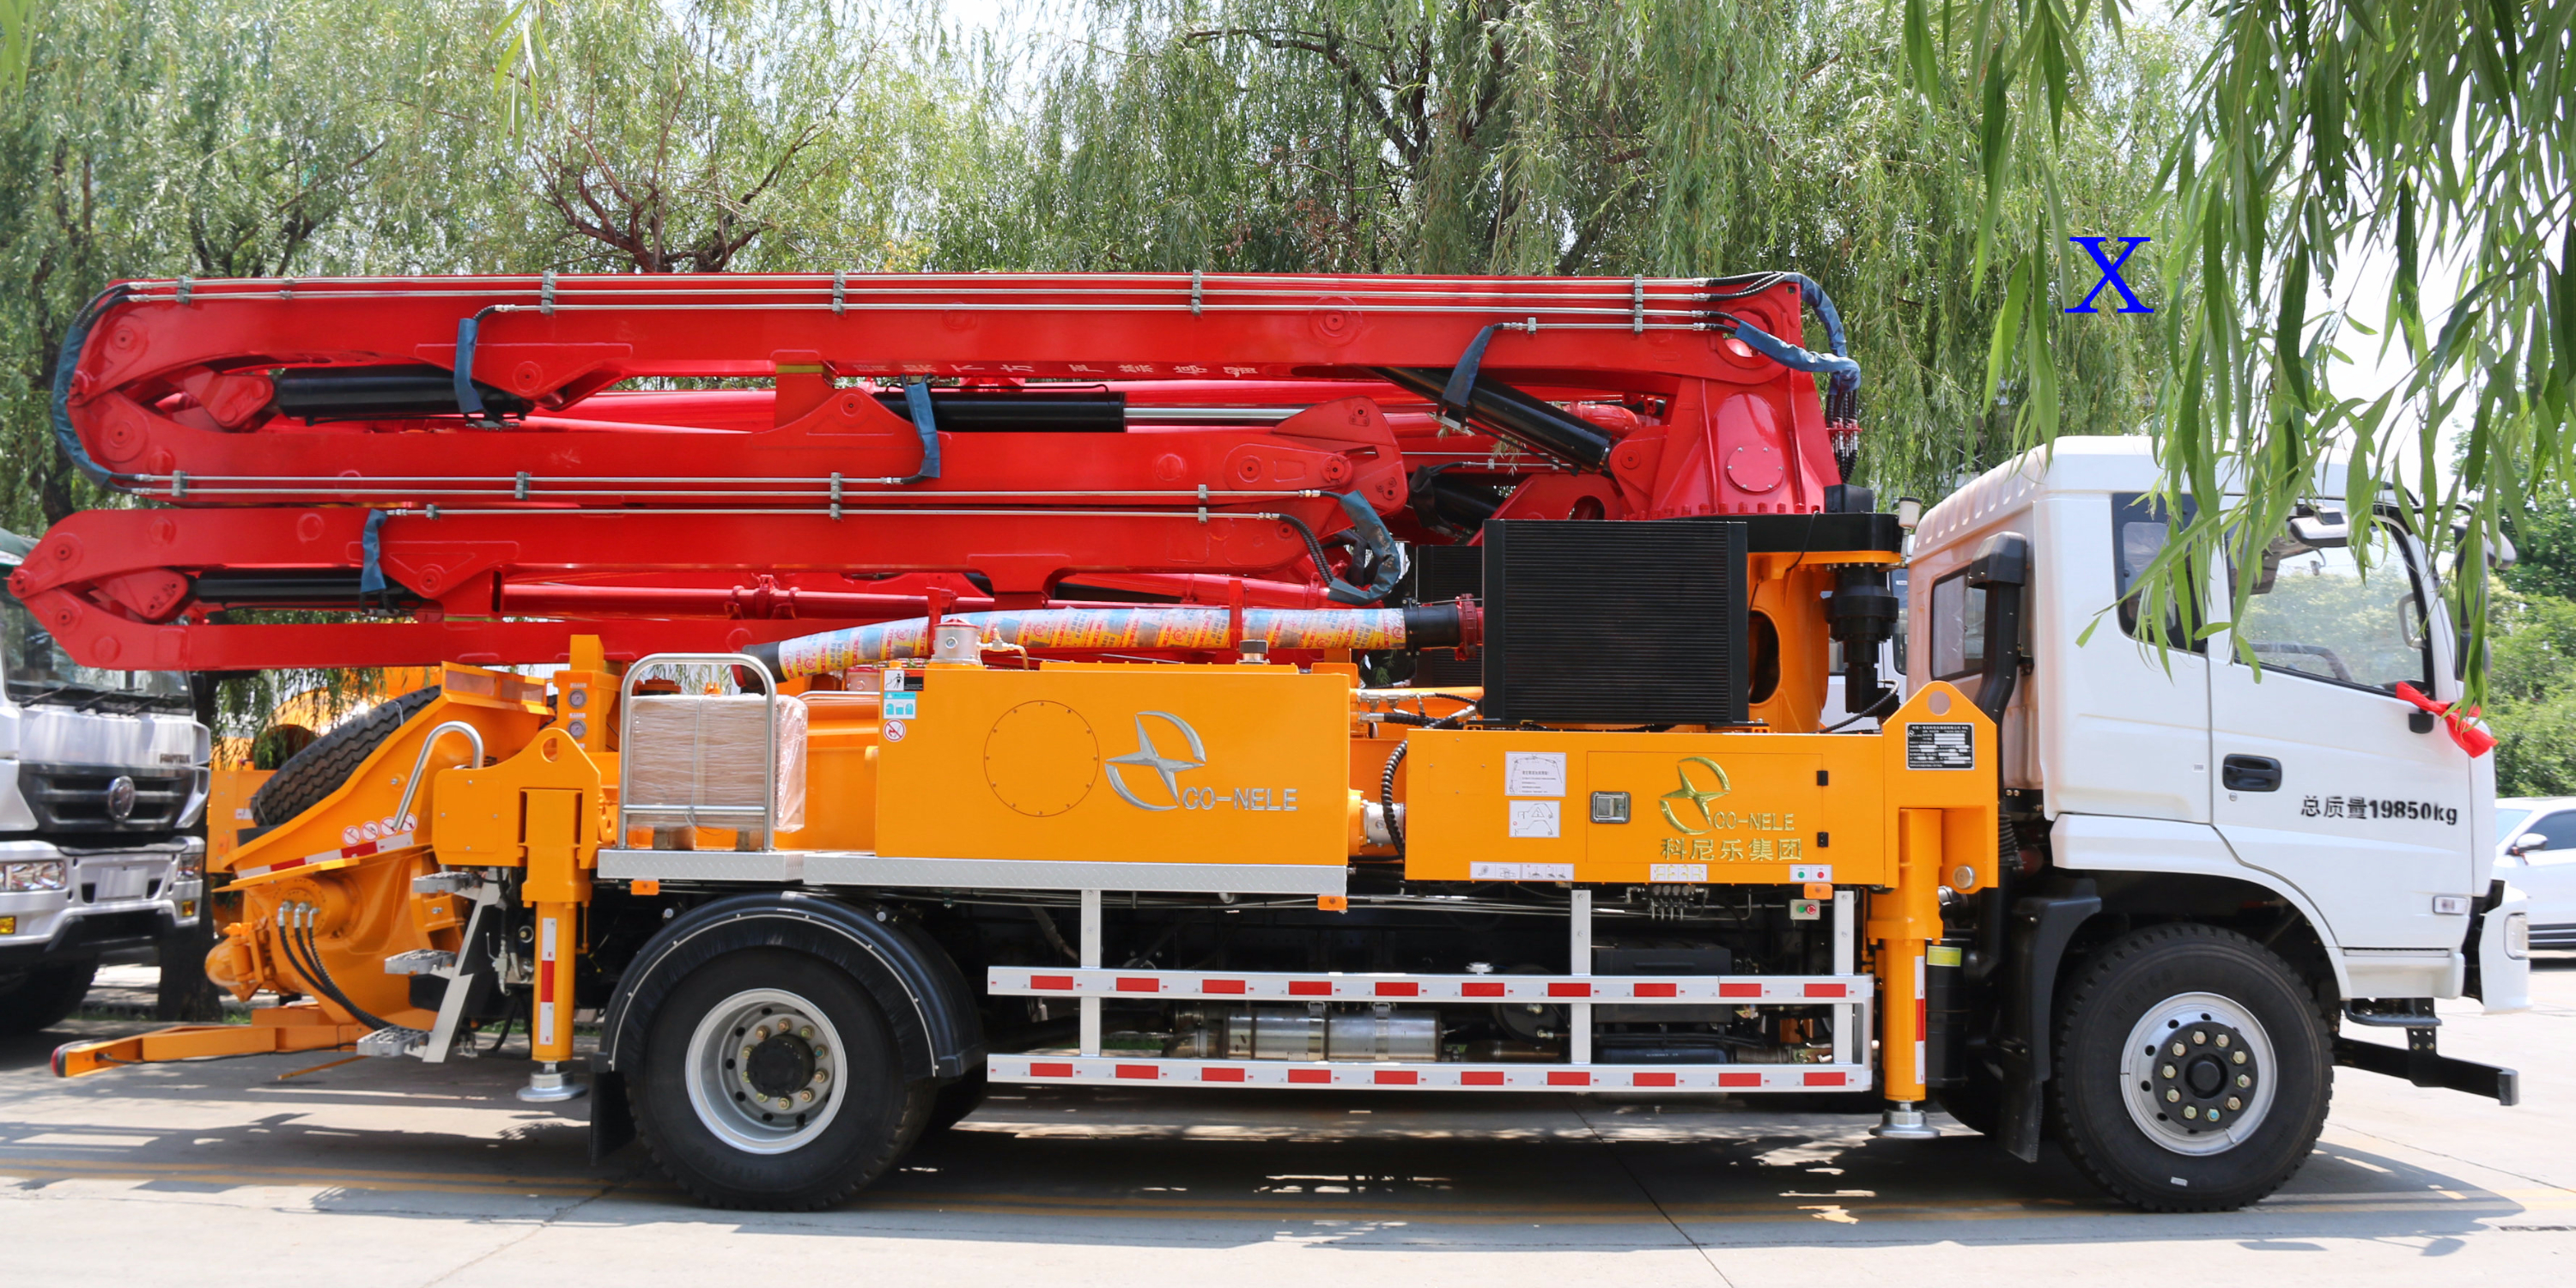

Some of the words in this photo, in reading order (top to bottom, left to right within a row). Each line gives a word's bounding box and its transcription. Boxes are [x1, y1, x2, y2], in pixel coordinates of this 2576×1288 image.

[1182, 787, 1298, 811] CO-NELE
[2300, 795, 2458, 825] 总质量19850kg
[1713, 811, 1795, 831] CO-NELE
[1661, 837, 1802, 861] 科尼乐集团
